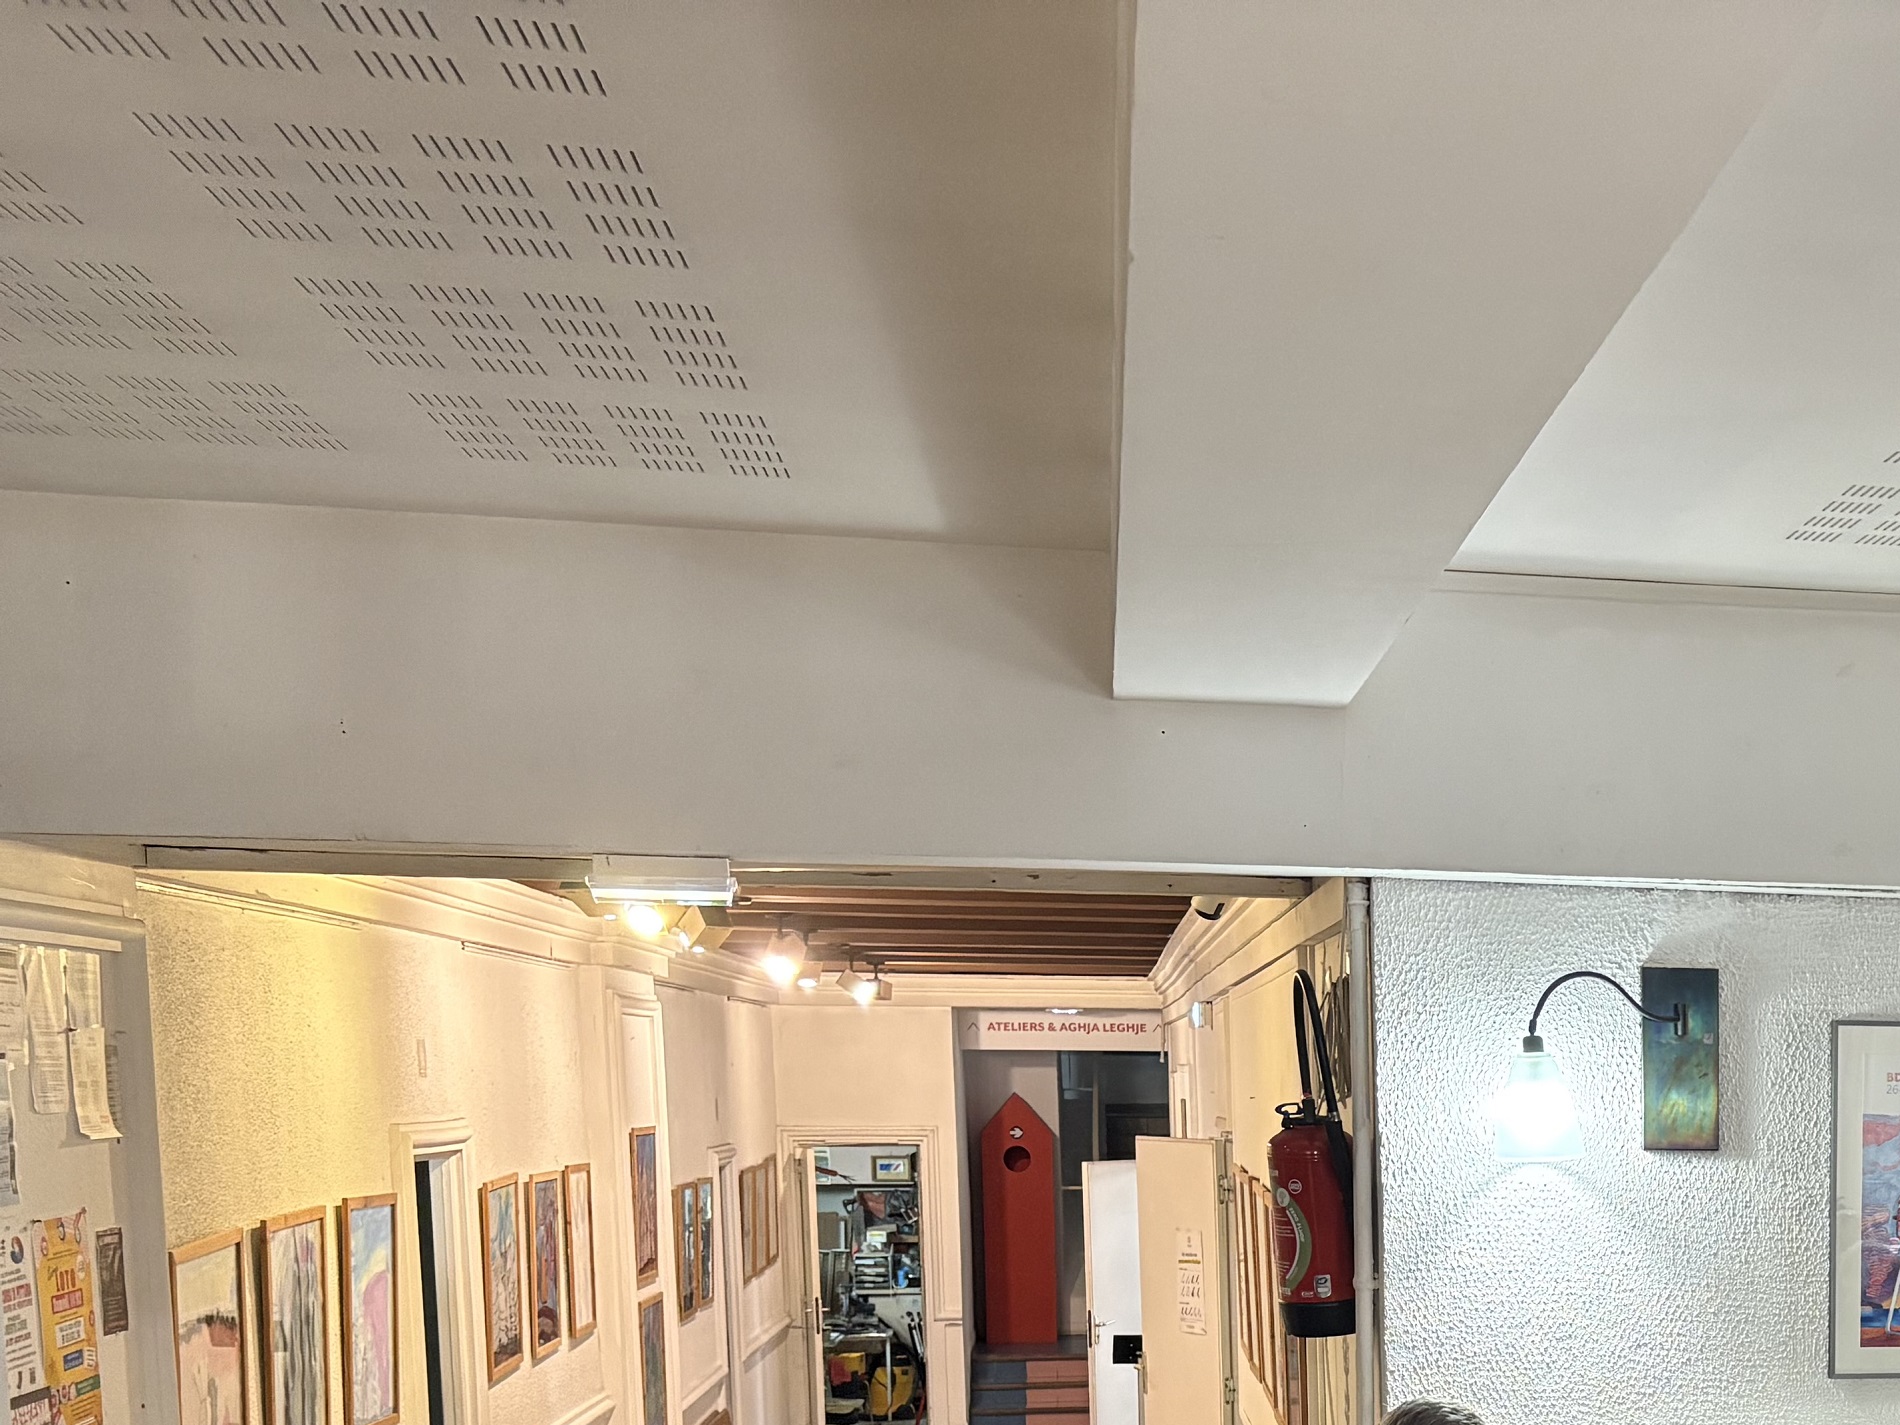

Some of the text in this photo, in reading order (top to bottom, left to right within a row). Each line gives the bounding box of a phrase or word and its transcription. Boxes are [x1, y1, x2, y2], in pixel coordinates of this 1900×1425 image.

[987, 1021, 1147, 1035] ATELIERS & AGHJA LEGHJE
